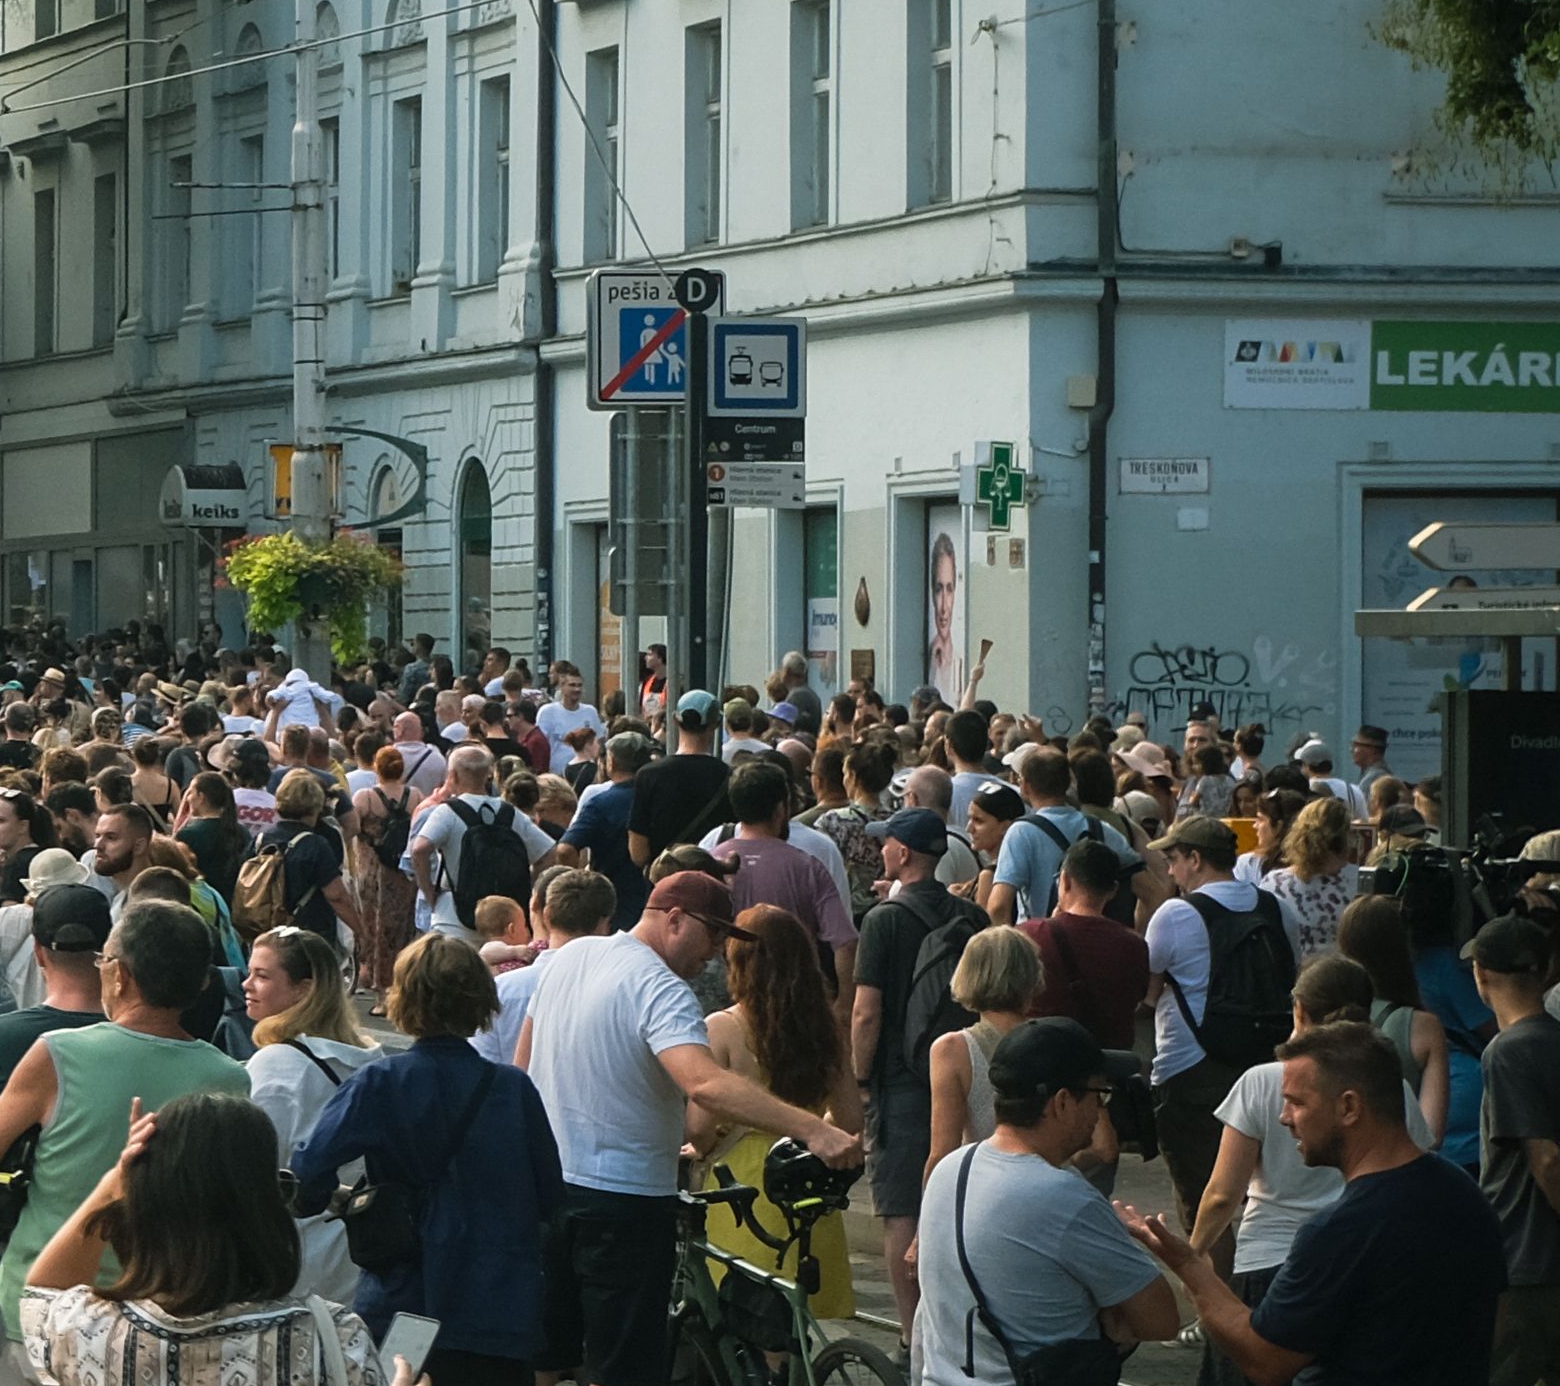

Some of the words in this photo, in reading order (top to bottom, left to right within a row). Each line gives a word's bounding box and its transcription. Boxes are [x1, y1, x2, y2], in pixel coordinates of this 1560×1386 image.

[608, 281, 660, 303] pešia
[687, 277, 707, 303] D
[1377, 343, 1560, 387] LEKÁR
[735, 424, 776, 433] Centrum
[192, 503, 239, 518] keiks
